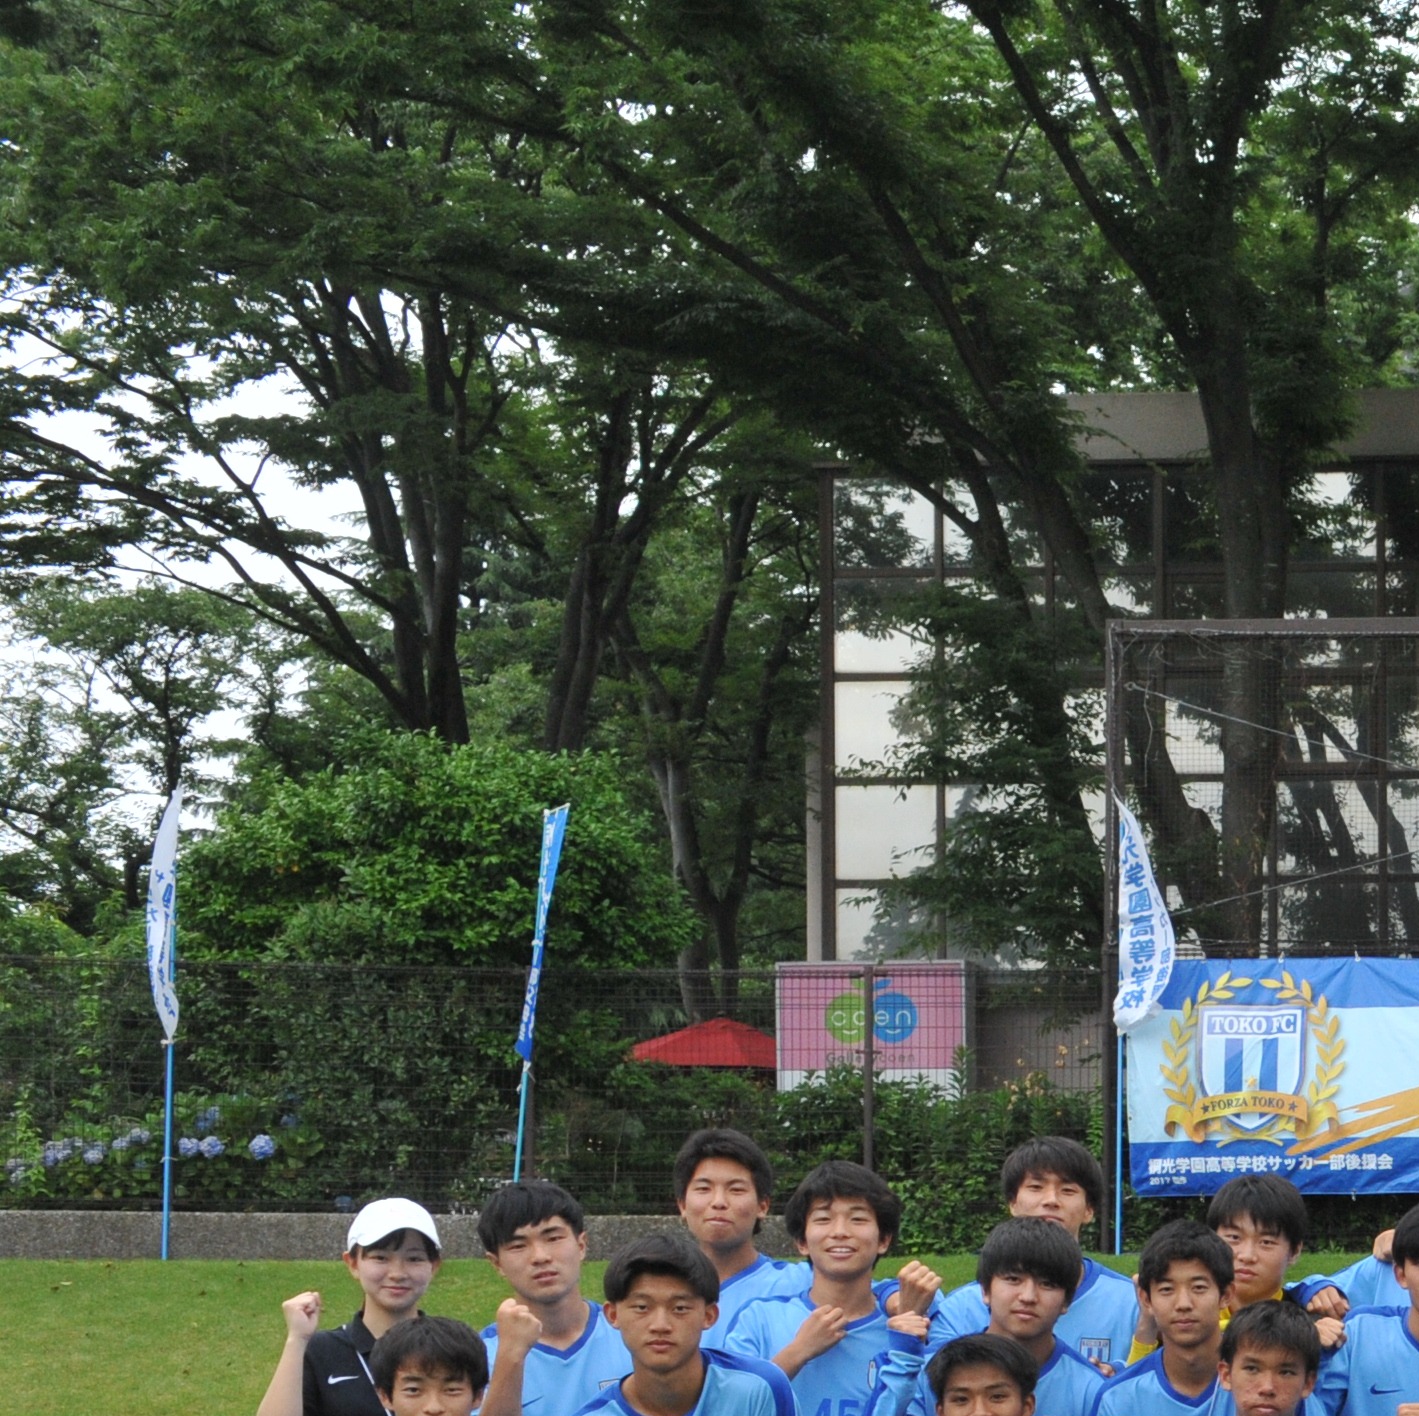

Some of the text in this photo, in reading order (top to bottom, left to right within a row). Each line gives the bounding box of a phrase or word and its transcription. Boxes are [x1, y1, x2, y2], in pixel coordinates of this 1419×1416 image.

[1211, 1015, 1295, 1033] TOKO FC
[1211, 1095, 1285, 1111] FORZA TOKO
